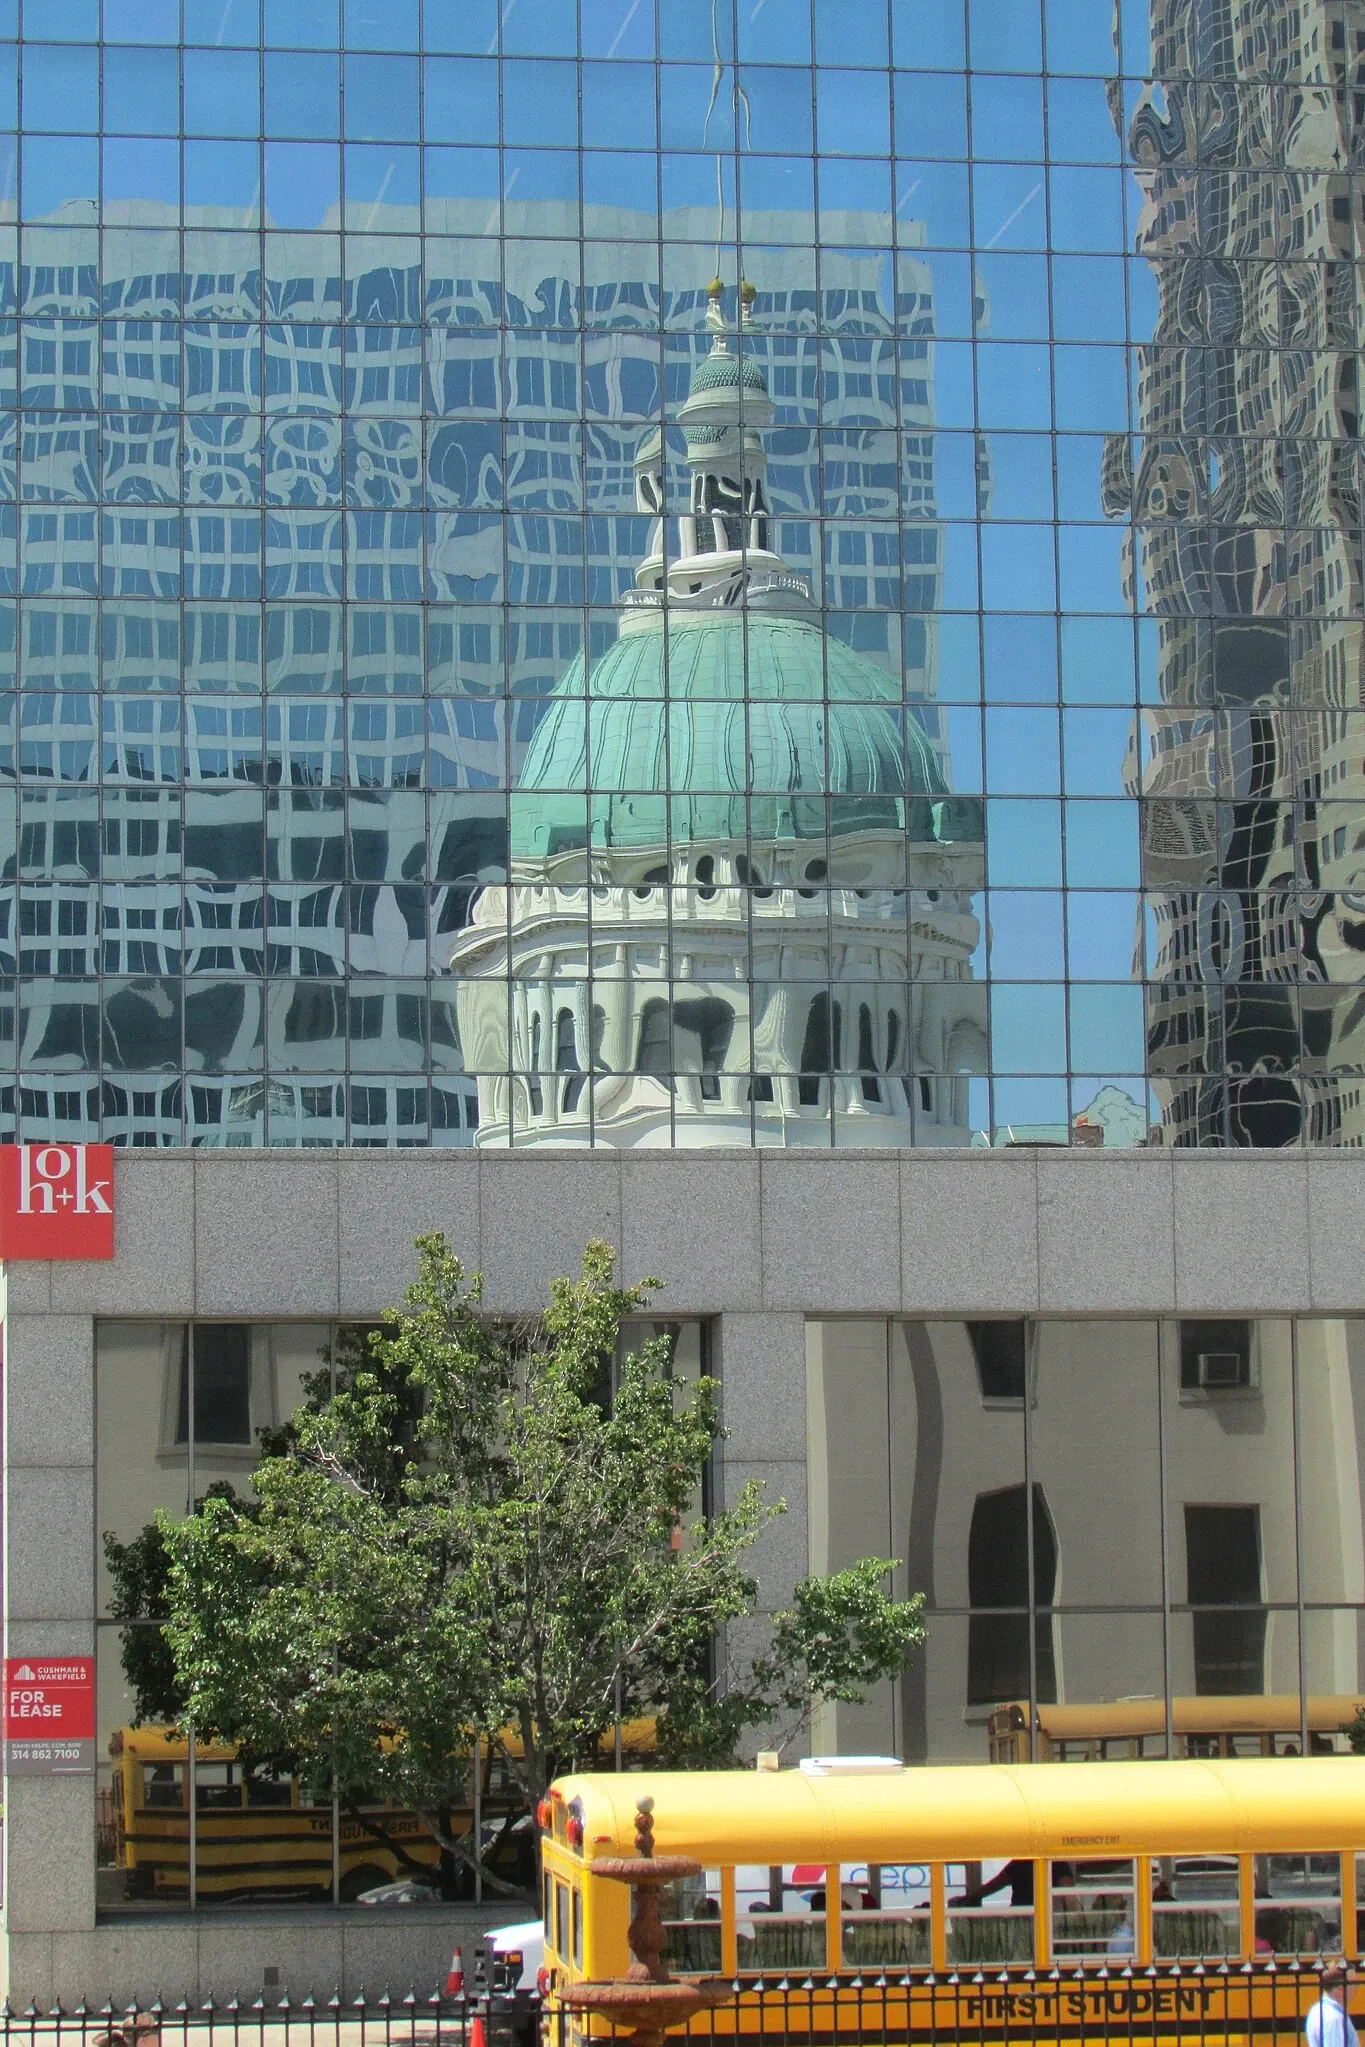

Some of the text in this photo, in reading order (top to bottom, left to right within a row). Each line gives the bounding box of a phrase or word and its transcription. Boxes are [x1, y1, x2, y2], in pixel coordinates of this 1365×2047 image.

[10, 1691, 44, 1704] FOR
[10, 1704, 62, 1717] LEASE
[11, 1749, 80, 1760] 314 862 7100
[1062, 1835, 1120, 1845] EMERGENCY EXIT
[966, 1988, 1216, 2019] FIRST STUDENT
